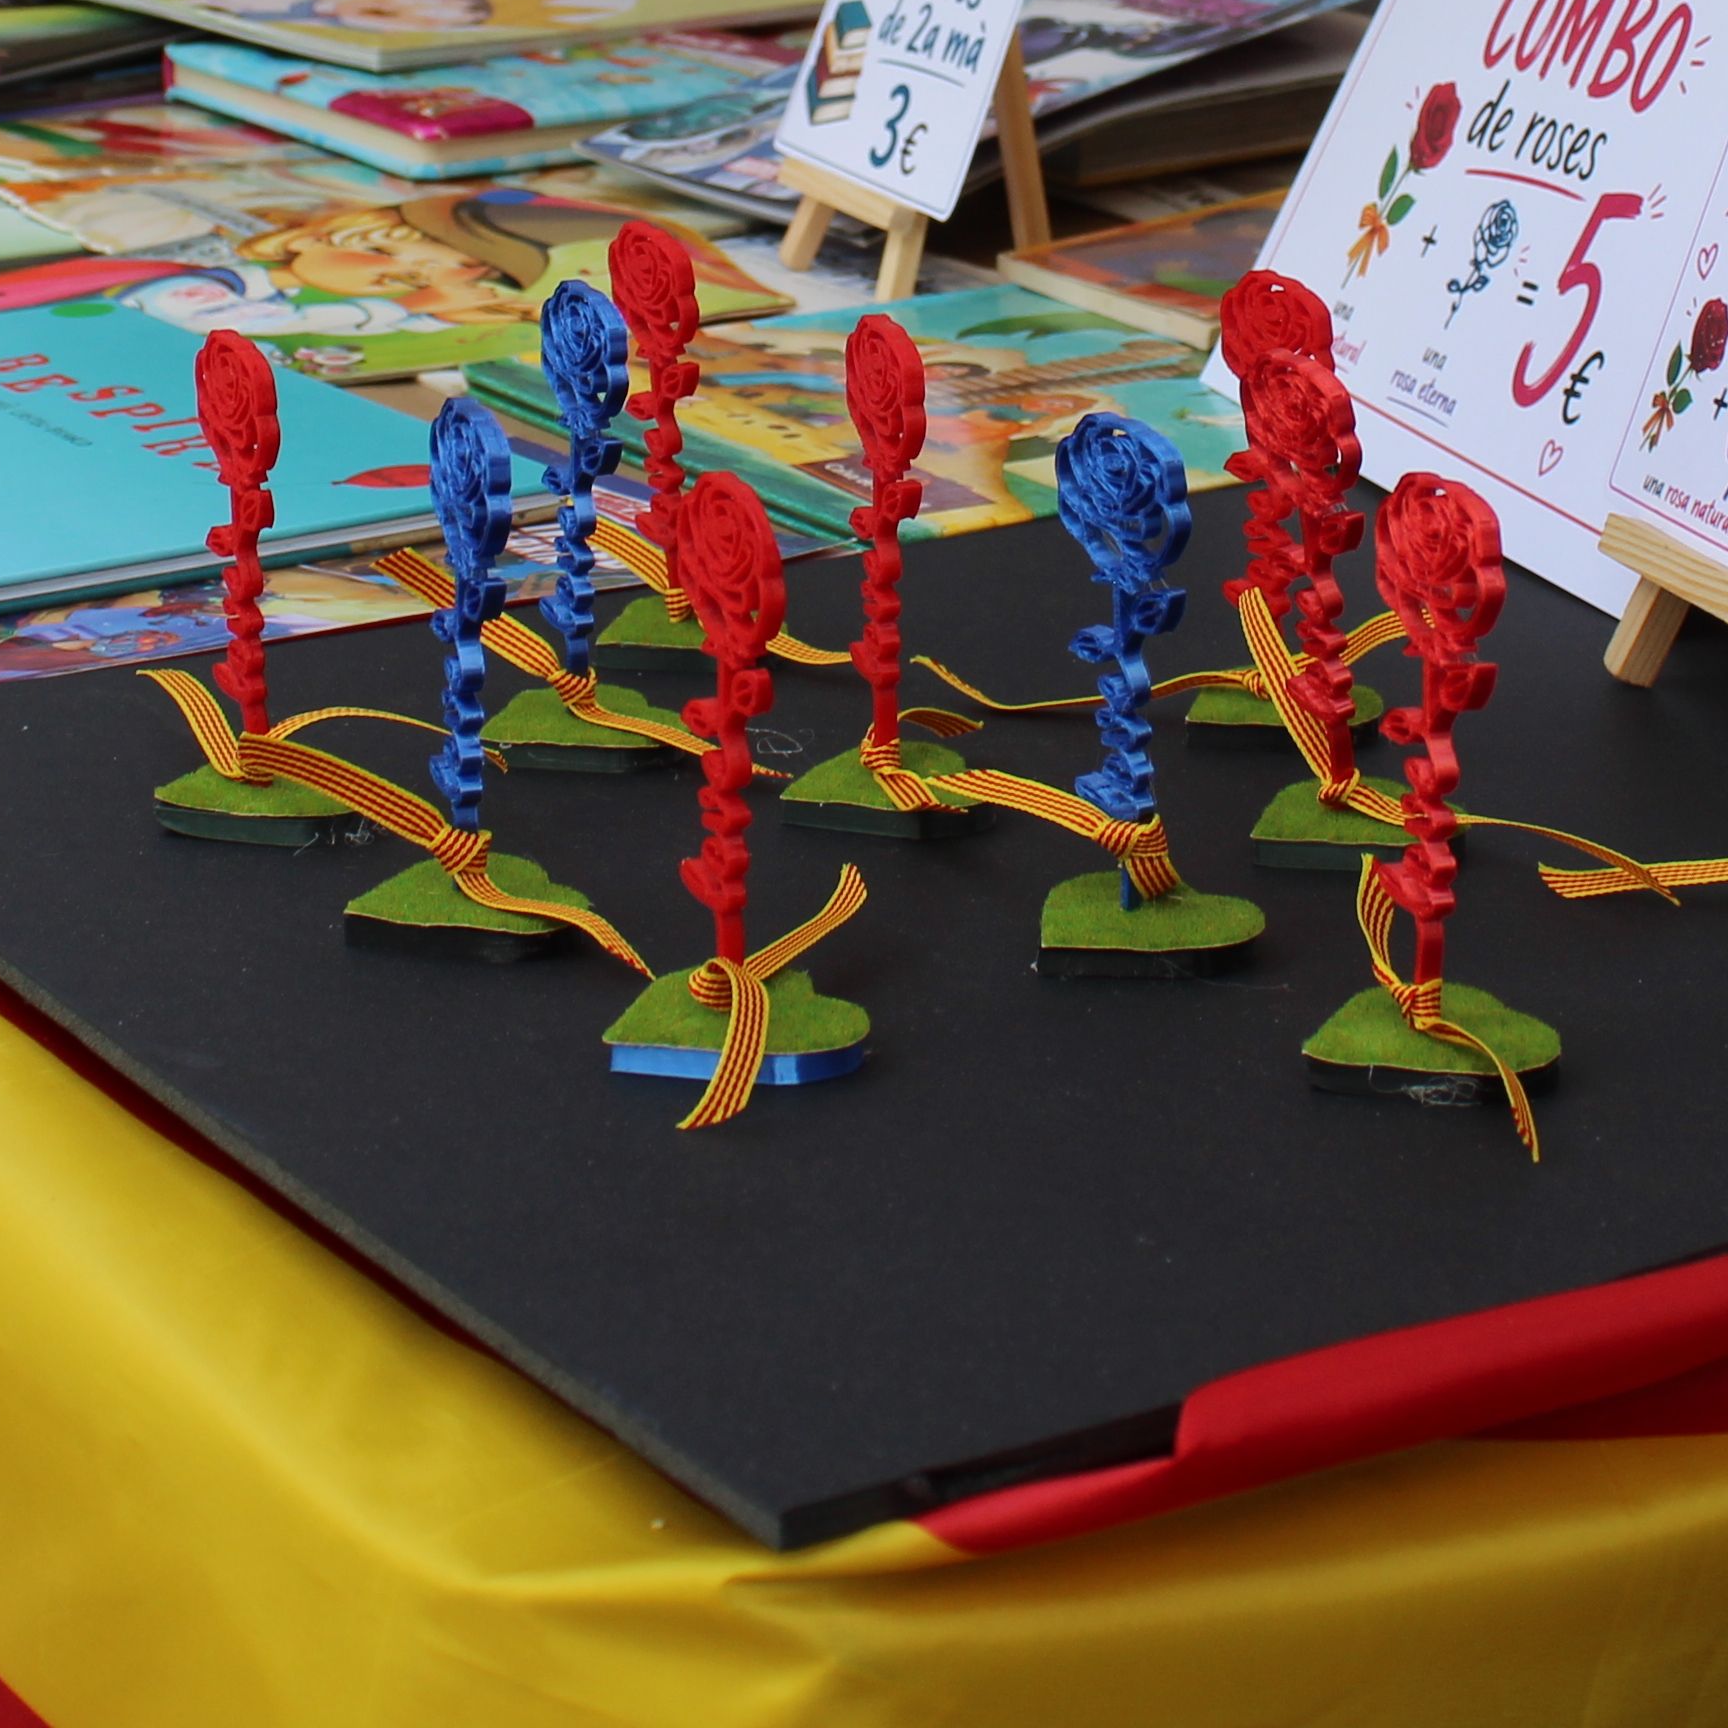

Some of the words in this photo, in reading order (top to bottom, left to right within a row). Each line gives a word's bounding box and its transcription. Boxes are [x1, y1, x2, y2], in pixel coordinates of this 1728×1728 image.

[907, 4, 936, 53] 2a
[943, 22, 987, 73] mà
[1467, 78, 1514, 152] de
[1515, 111, 1607, 180] roses
[1422, 347, 1448, 371] una
[1390, 369, 1417, 393] rosa
[1417, 378, 1458, 416] eterna
[1643, 473, 1665, 498] una
[1664, 485, 1689, 511] rosa
